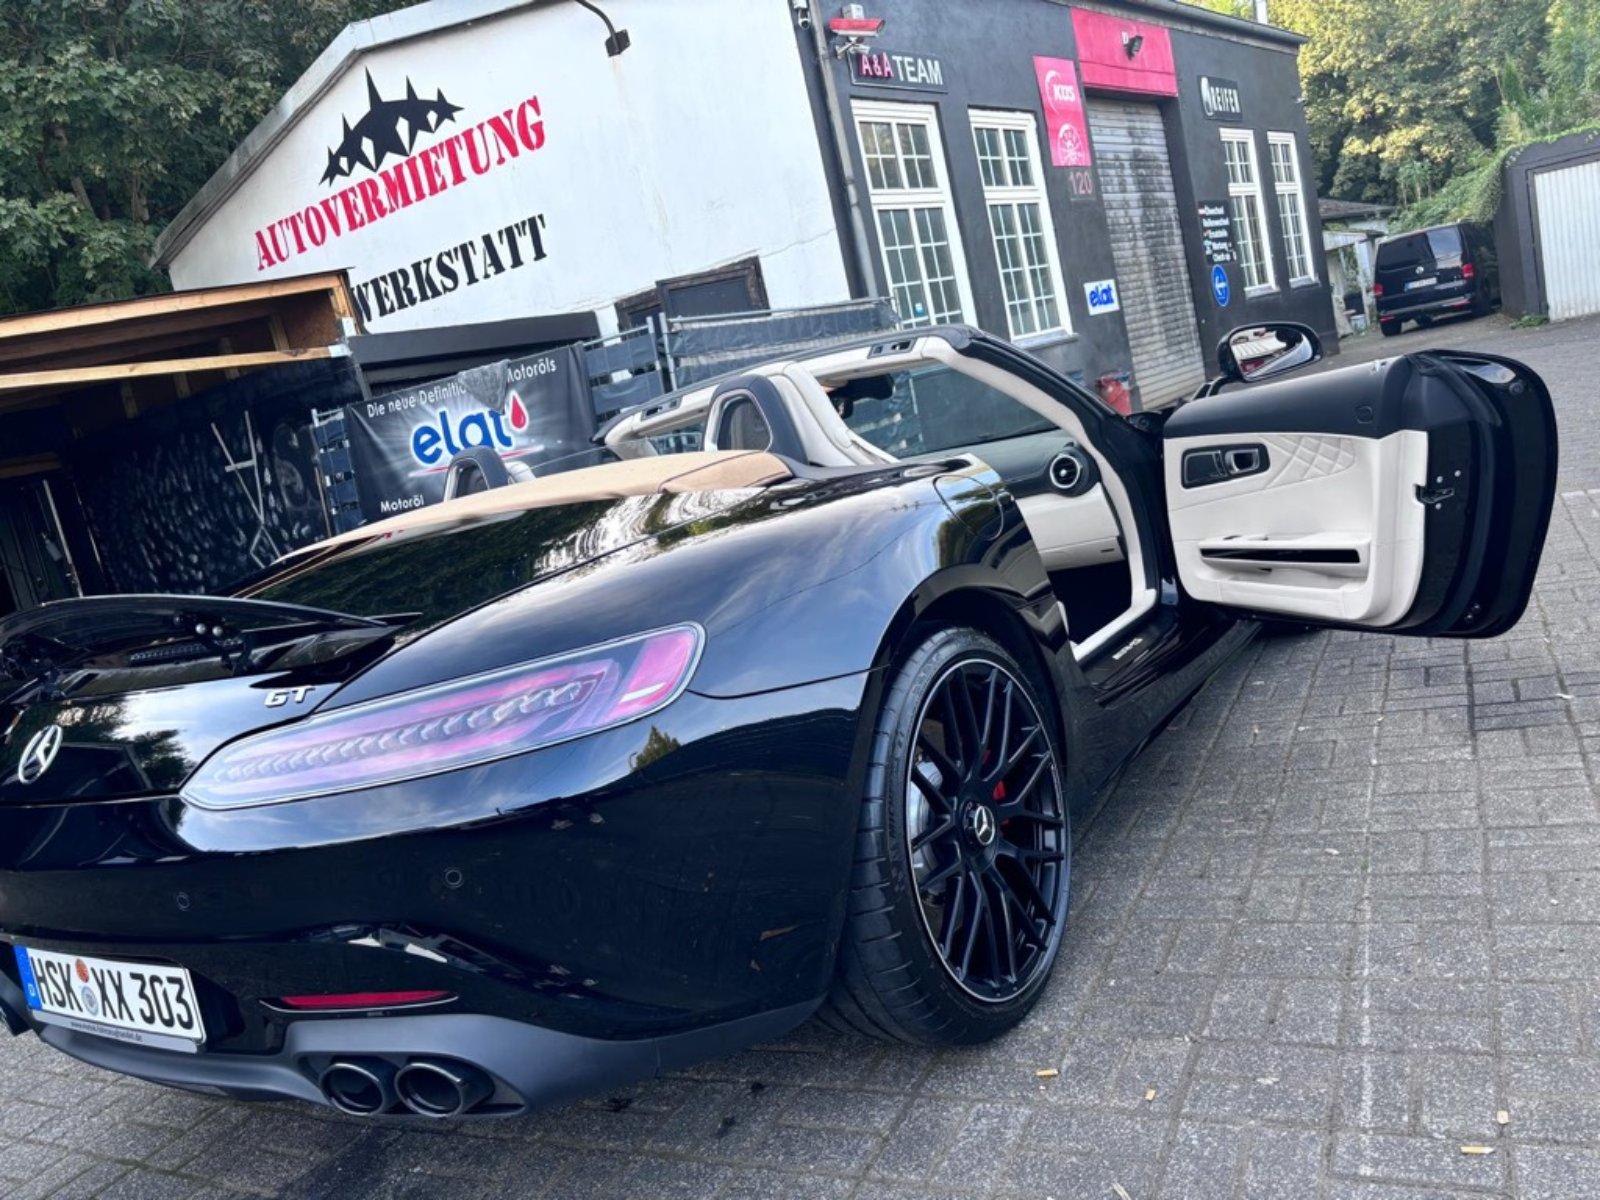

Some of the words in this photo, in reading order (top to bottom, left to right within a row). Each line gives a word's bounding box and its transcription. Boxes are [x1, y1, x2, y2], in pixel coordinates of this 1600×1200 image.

[862, 52, 894, 77] A&A
[892, 55, 944, 85] TEAM
[254, 95, 546, 271] AUTOVERMIETUNG
[1068, 171, 1093, 194] 120
[350, 213, 548, 323] WERKSTATT
[1089, 284, 1114, 307] elat
[367, 403, 386, 418] Die
[388, 396, 416, 412] neue
[419, 382, 467, 404] Definitio
[413, 410, 512, 464] elat
[380, 494, 424, 513] Motoröl
[264, 687, 316, 708] GT
[31, 956, 83, 1013] HSK
[90, 966, 135, 1022] XX
[129, 971, 194, 1030] 303
